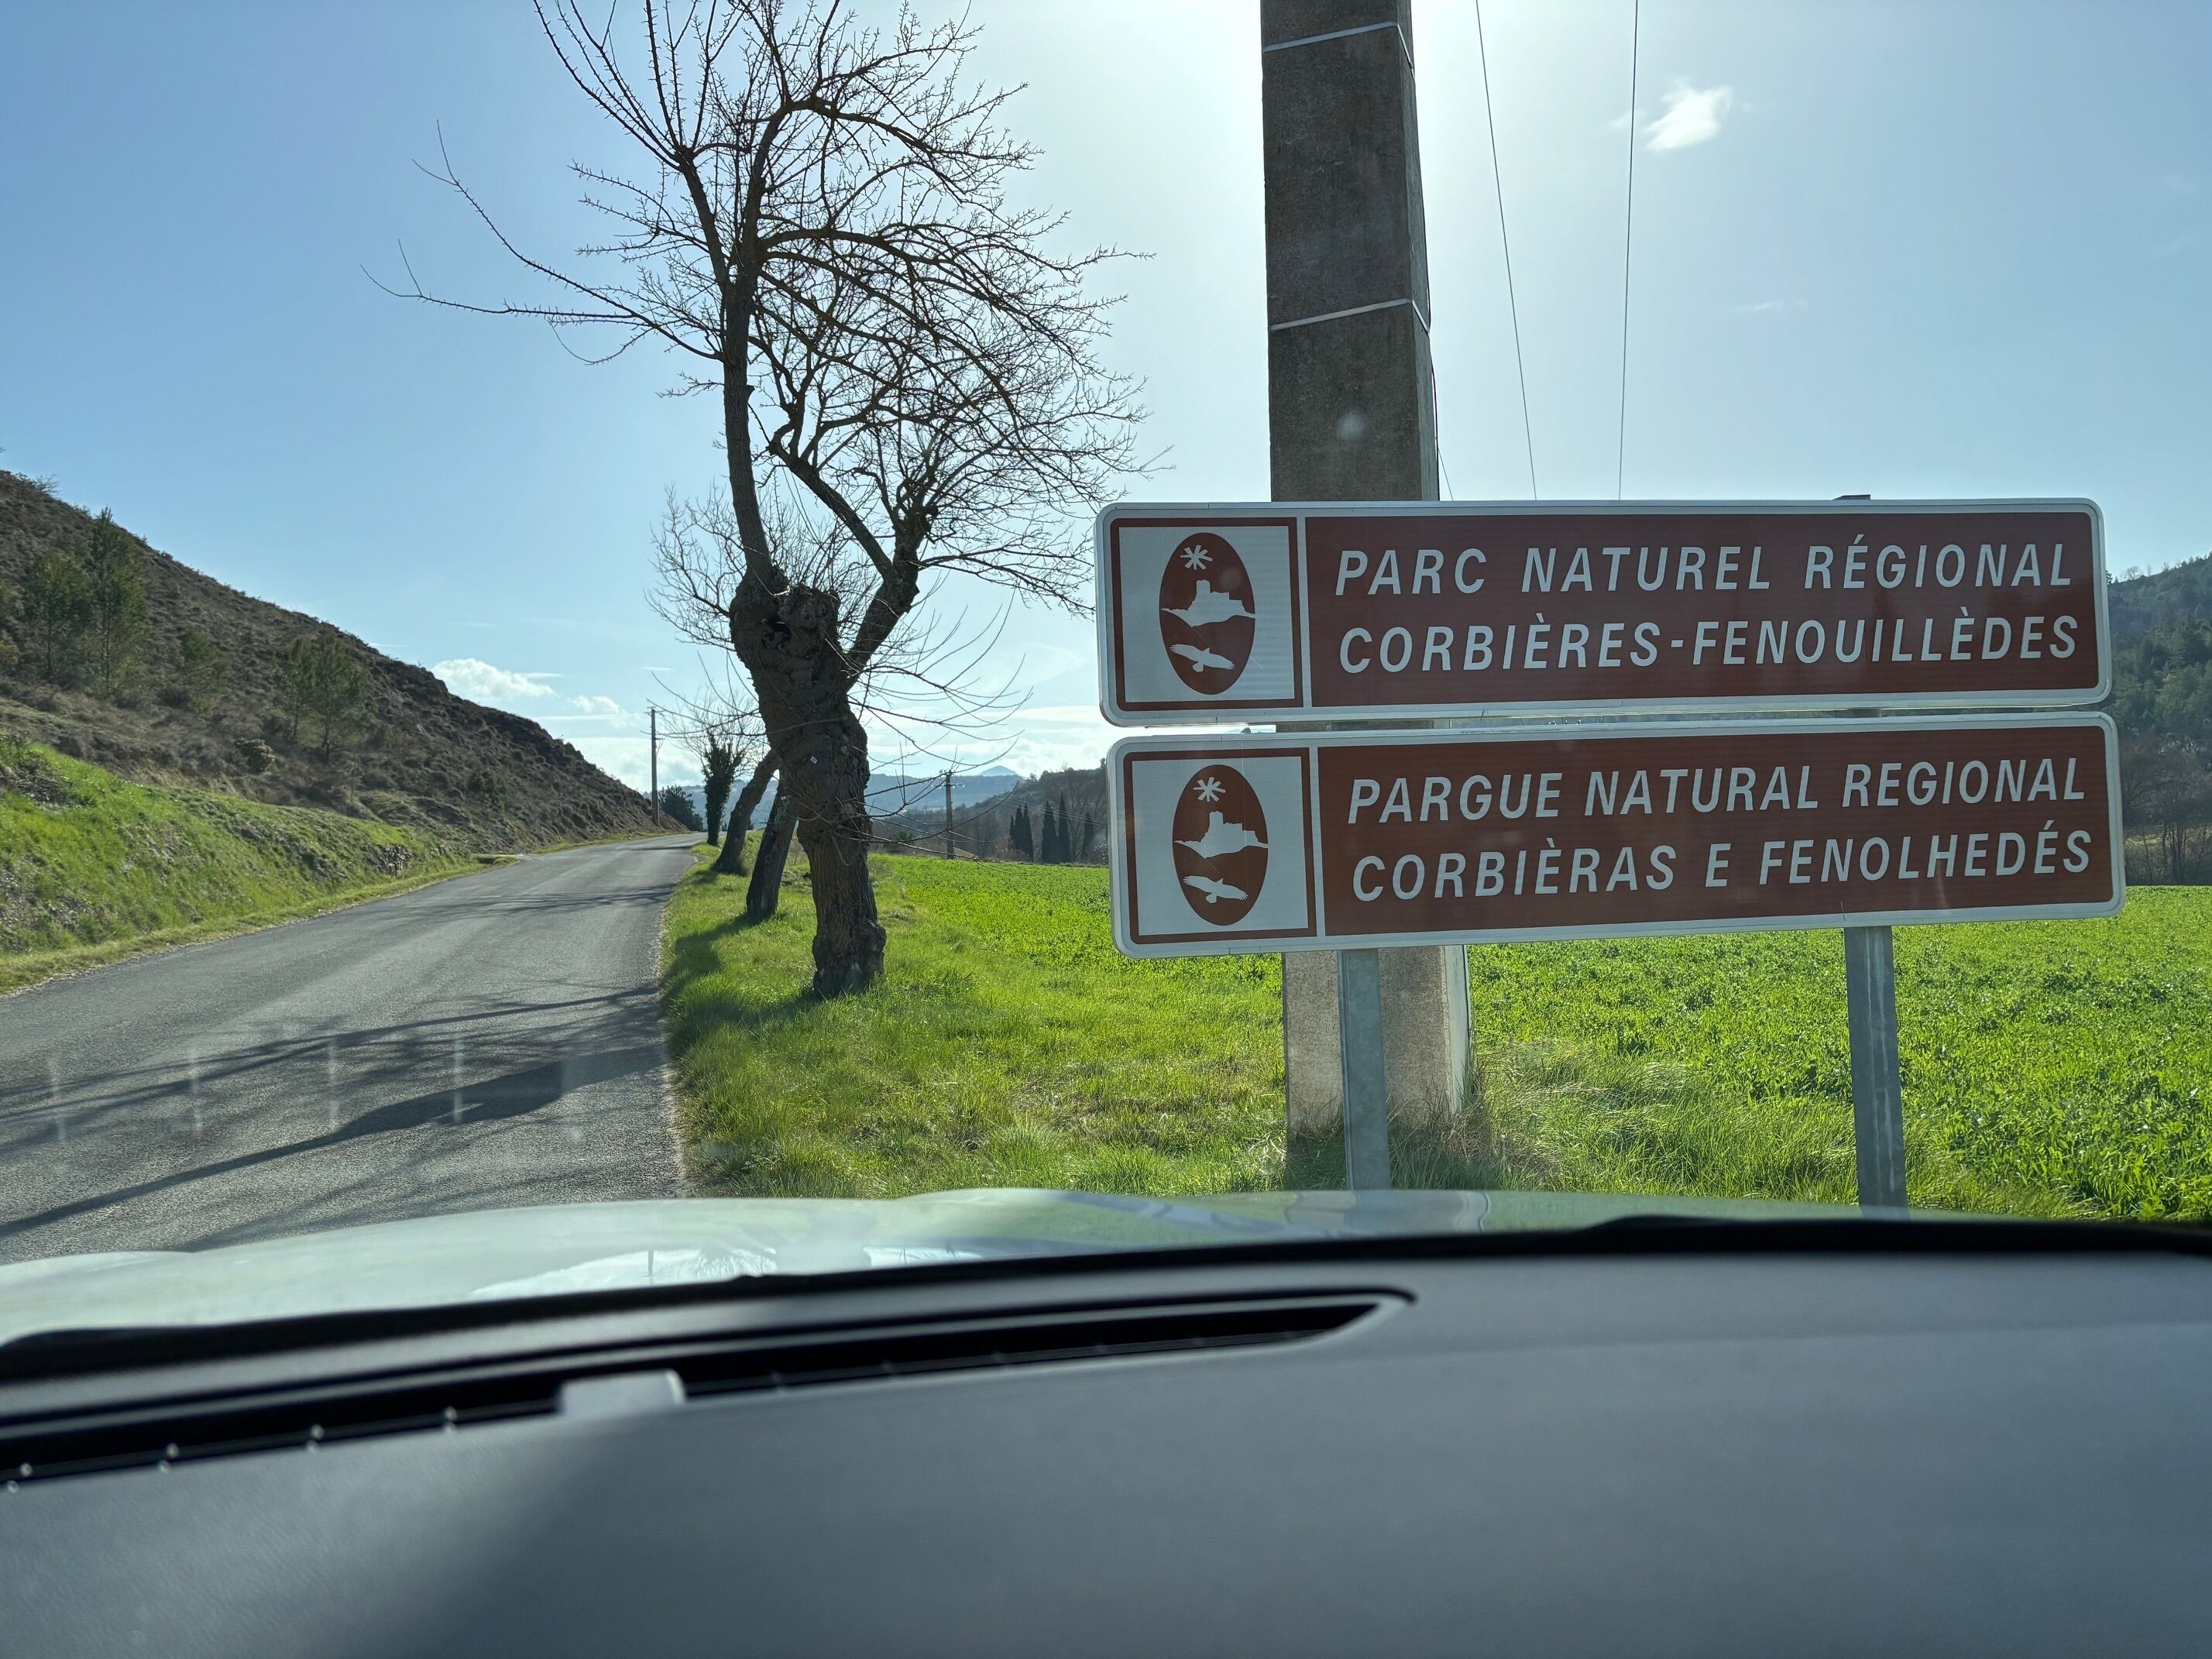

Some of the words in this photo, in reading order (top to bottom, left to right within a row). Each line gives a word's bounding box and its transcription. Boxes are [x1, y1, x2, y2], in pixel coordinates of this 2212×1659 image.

[1335, 547, 1487, 596] PARC
[1521, 545, 1771, 593] NATUREL
[1804, 534, 2072, 589] RÉGIONAL
[1340, 606, 2079, 674] CORBIÈRES-FENOUILLÈDES
[1348, 772, 1563, 824] PARGUE
[1584, 765, 1819, 816] NATURAL
[1842, 757, 2085, 808] REGIONAL
[1352, 837, 1677, 902] CORBIÈRAS
[1705, 843, 1732, 888] E
[1759, 819, 2092, 885] FENOLHEDÉS
